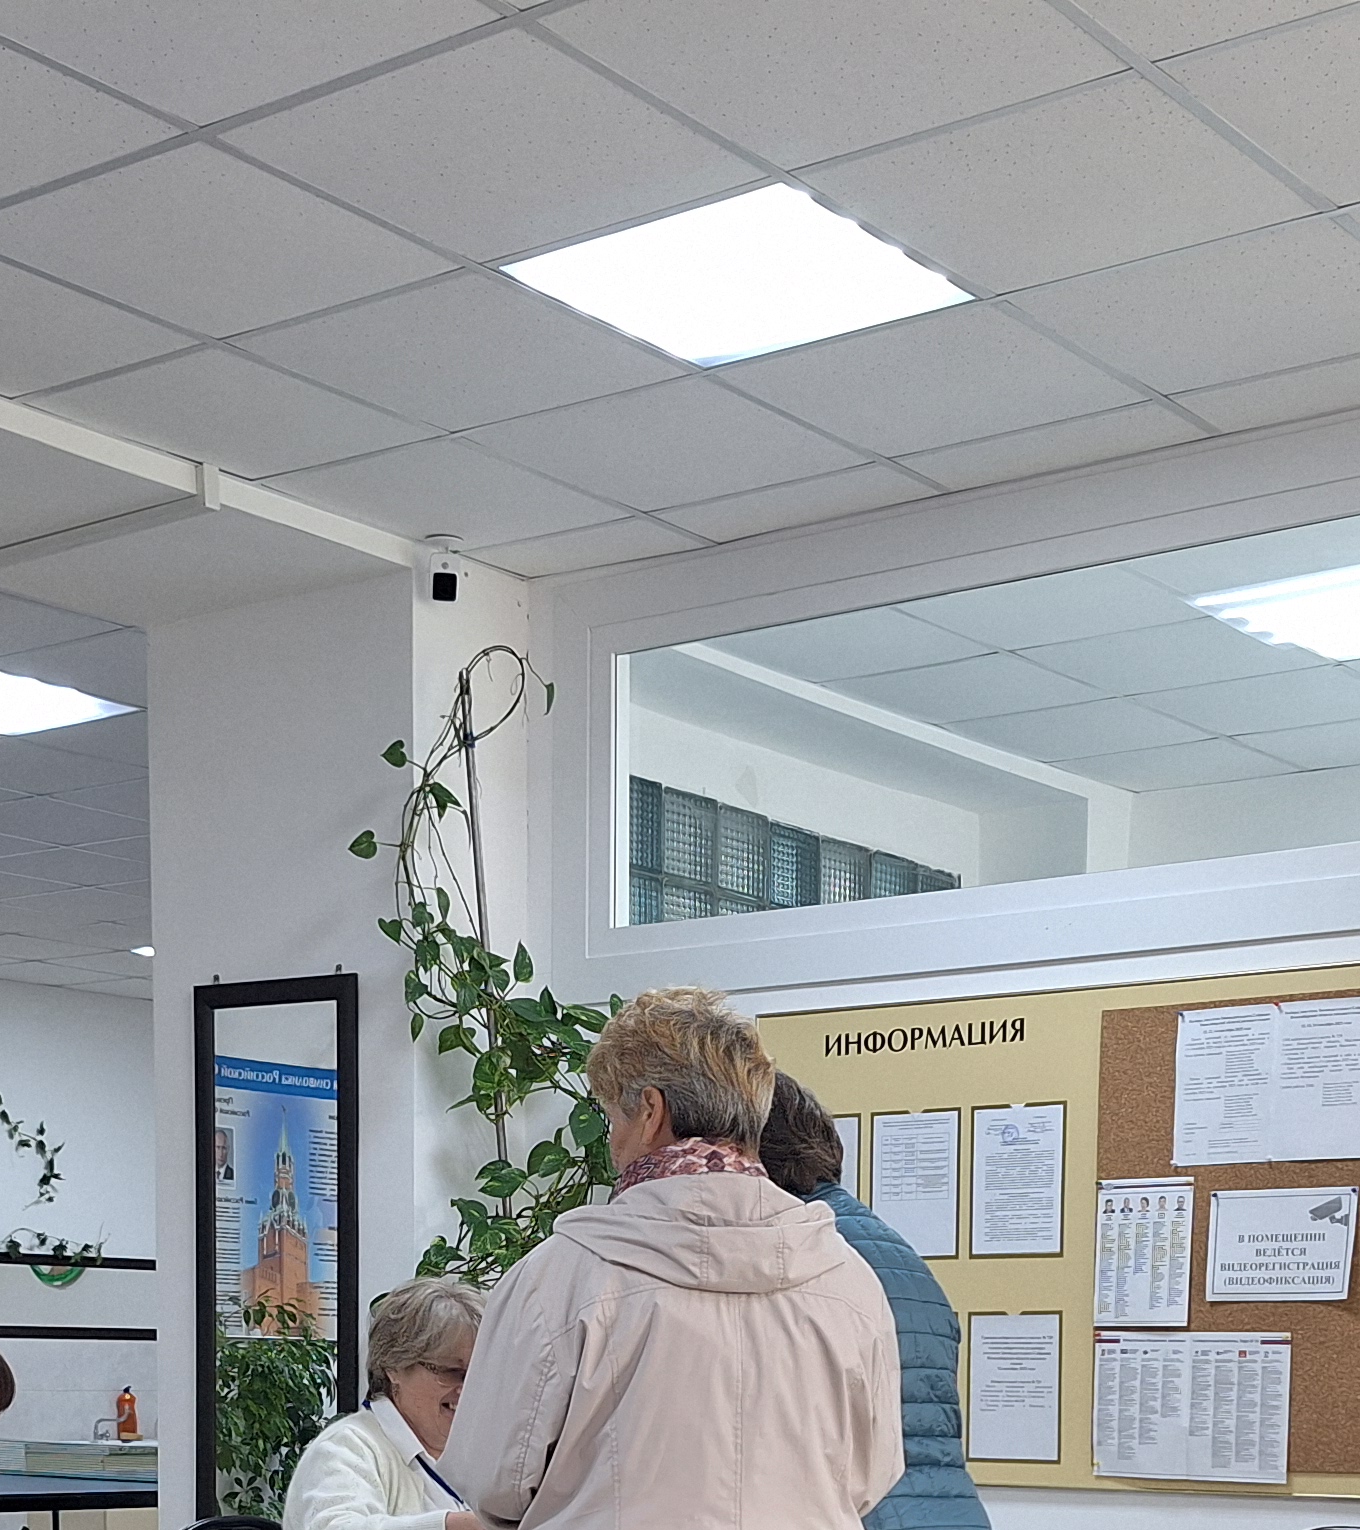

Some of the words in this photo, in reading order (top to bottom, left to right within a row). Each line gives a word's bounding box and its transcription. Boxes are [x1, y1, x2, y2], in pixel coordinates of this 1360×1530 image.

[825, 1018, 1025, 1057] ИНФОРМАЦИЯ
[1238, 1234, 1245, 1243] В
[1248, 1233, 1326, 1244] ПОМЕЩЕНИИ
[1255, 1246, 1307, 1258] ВЕДЁТСЯ
[1220, 1261, 1341, 1272] ВИДЕОРЕГИСТРАЦИЯ
[1223, 1276, 1335, 1287] (ВИДЕОФИКСАЦИЯ)
